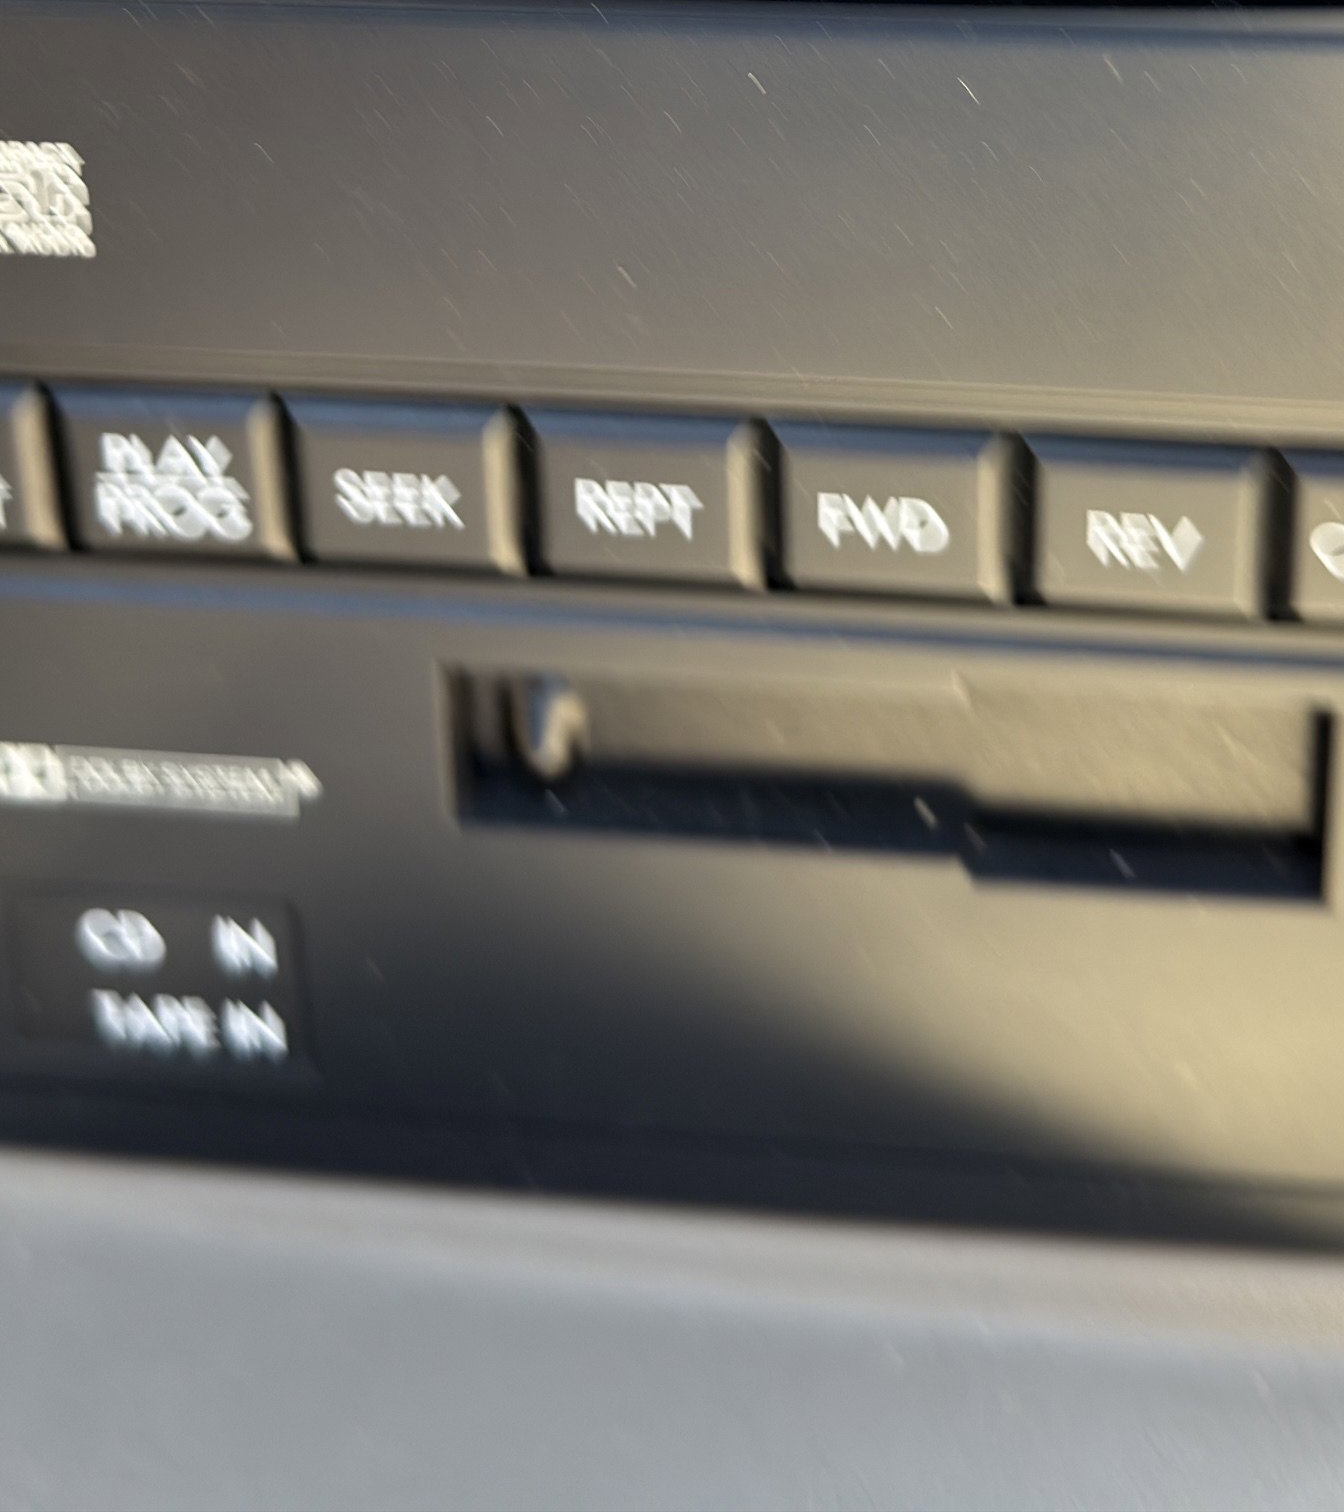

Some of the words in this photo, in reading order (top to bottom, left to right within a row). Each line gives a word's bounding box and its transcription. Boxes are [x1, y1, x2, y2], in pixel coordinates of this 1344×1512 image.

[334, 467, 464, 529] SEEK
[574, 477, 704, 541] REPT
[817, 492, 950, 553] FWD
[1085, 508, 1204, 572] REV
